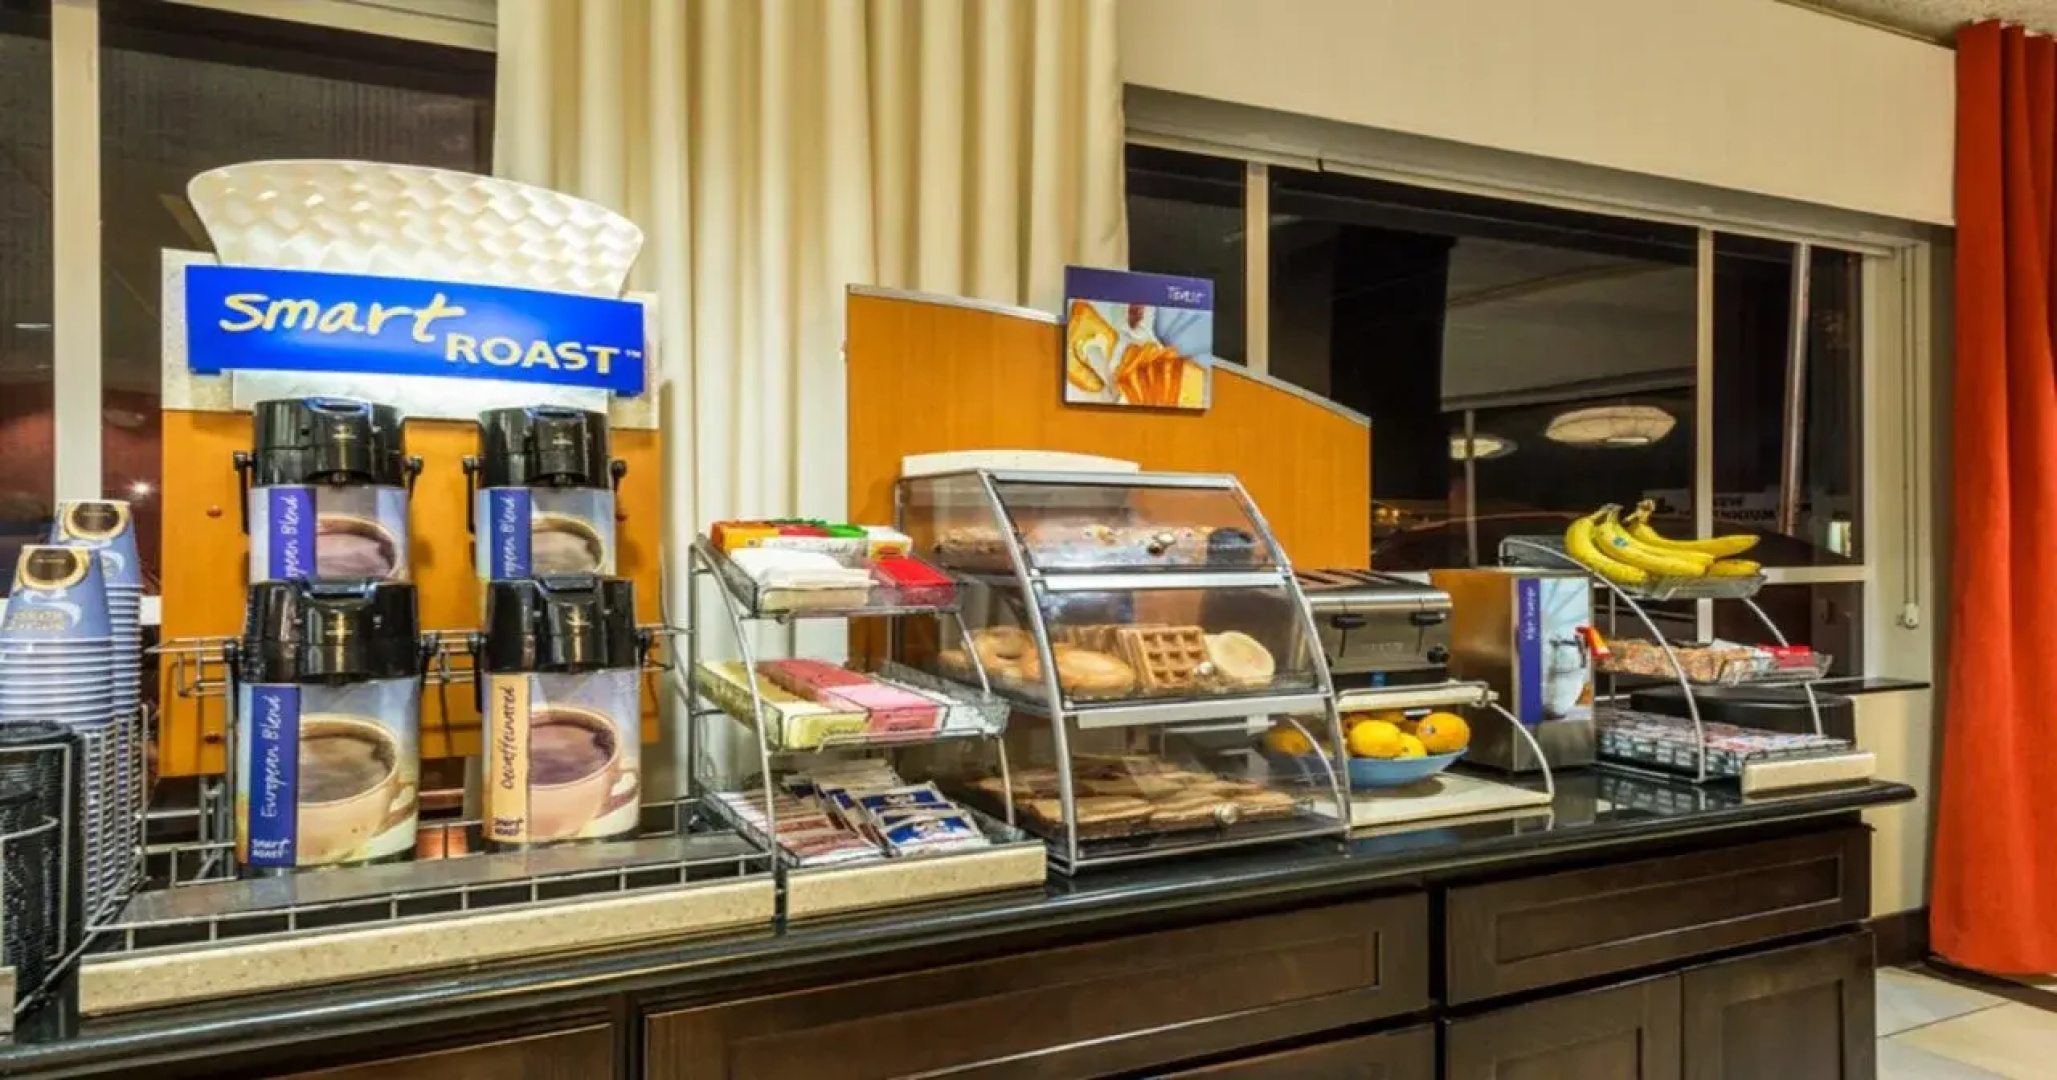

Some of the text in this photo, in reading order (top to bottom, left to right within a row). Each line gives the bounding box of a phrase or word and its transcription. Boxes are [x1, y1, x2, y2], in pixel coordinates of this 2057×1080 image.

[219, 293, 466, 343] Smart
[445, 333, 620, 374] ROAST
[278, 494, 300, 535] Blend
[498, 496, 525, 578] ropean Blend
[260, 695, 288, 818] European Blend
